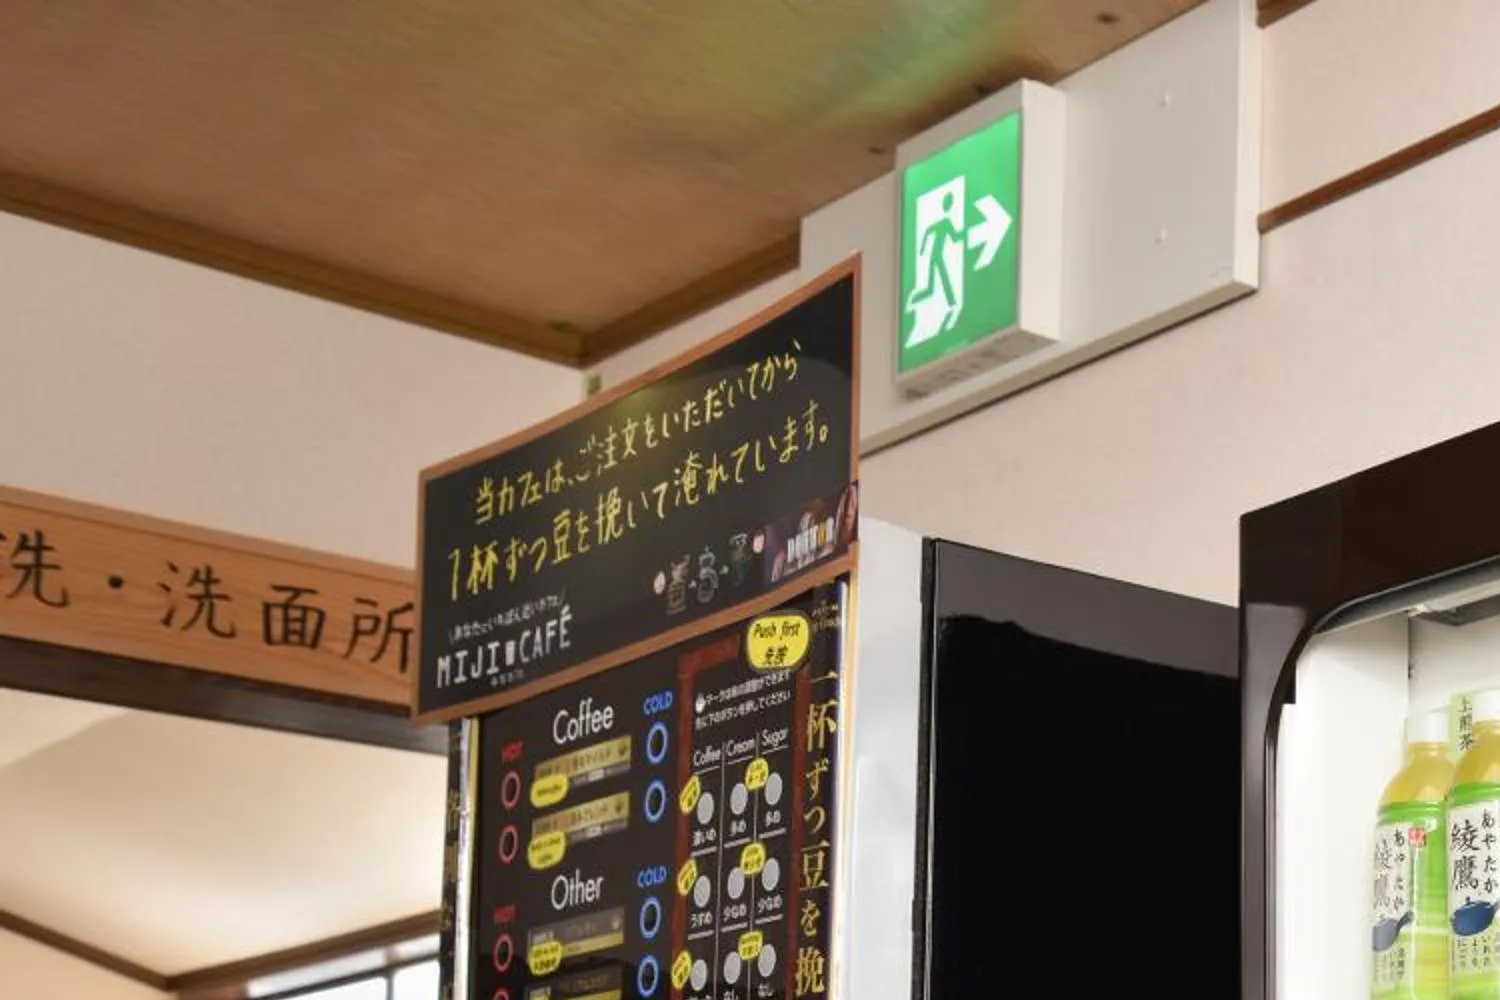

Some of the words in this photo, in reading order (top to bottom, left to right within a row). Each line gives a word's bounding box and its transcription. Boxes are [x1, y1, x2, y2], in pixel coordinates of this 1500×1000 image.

[754, 624, 776, 639] Push
[780, 623, 800, 640] first
[643, 691, 673, 715] COLD
[553, 698, 614, 744] Coffee
[761, 728, 789, 746] Sugar
[551, 868, 604, 909] Other
[637, 866, 667, 888] COLD
